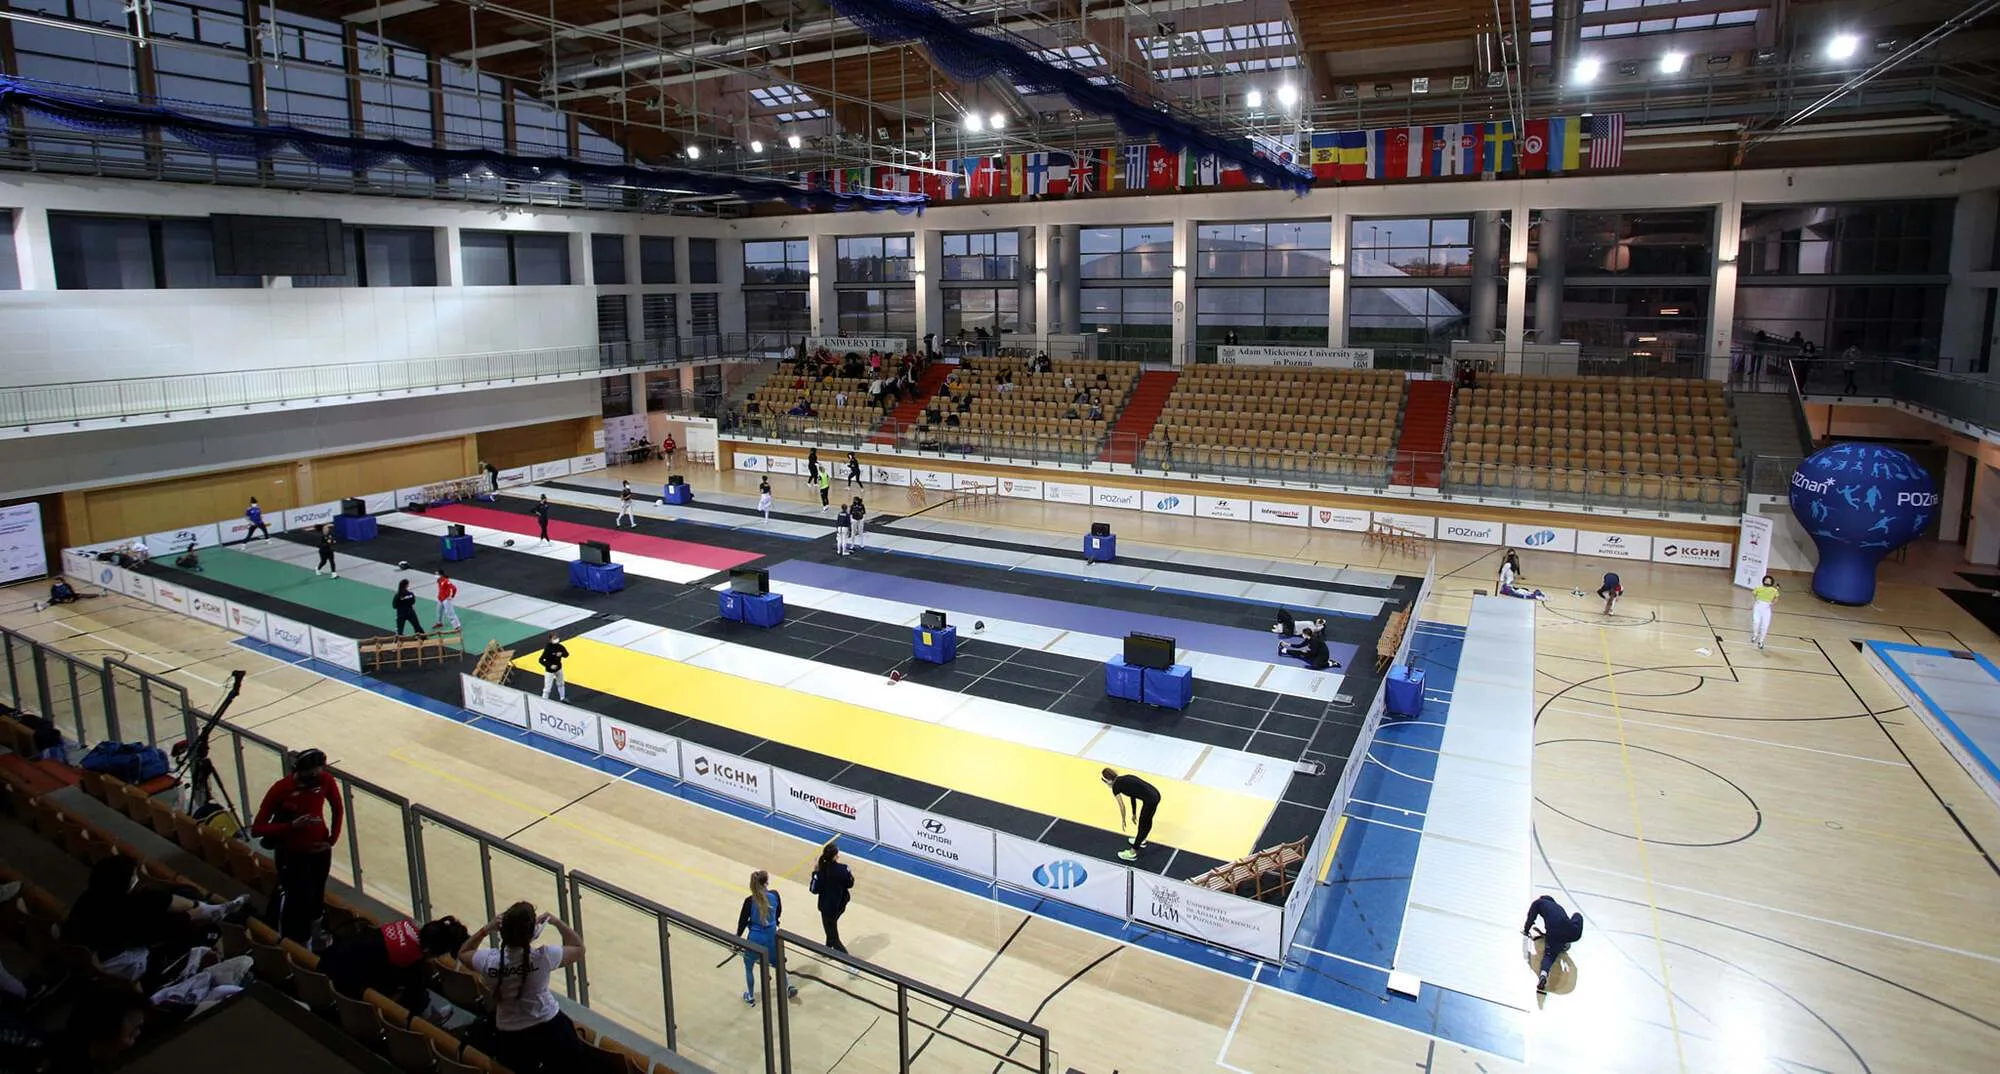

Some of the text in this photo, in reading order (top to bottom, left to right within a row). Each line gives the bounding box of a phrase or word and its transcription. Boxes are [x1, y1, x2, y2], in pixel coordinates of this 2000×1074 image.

[824, 338, 887, 348] UNIWERSYTET
[1238, 348, 1351, 360] Adam Mickiewicz University
[1283, 358, 1313, 367] Poznań
[1681, 547, 1720, 558] KGHM
[714, 763, 758, 787] KGHM
[917, 830, 952, 845] HYUNDAI
[911, 840, 959, 861] AUTO CLUB
